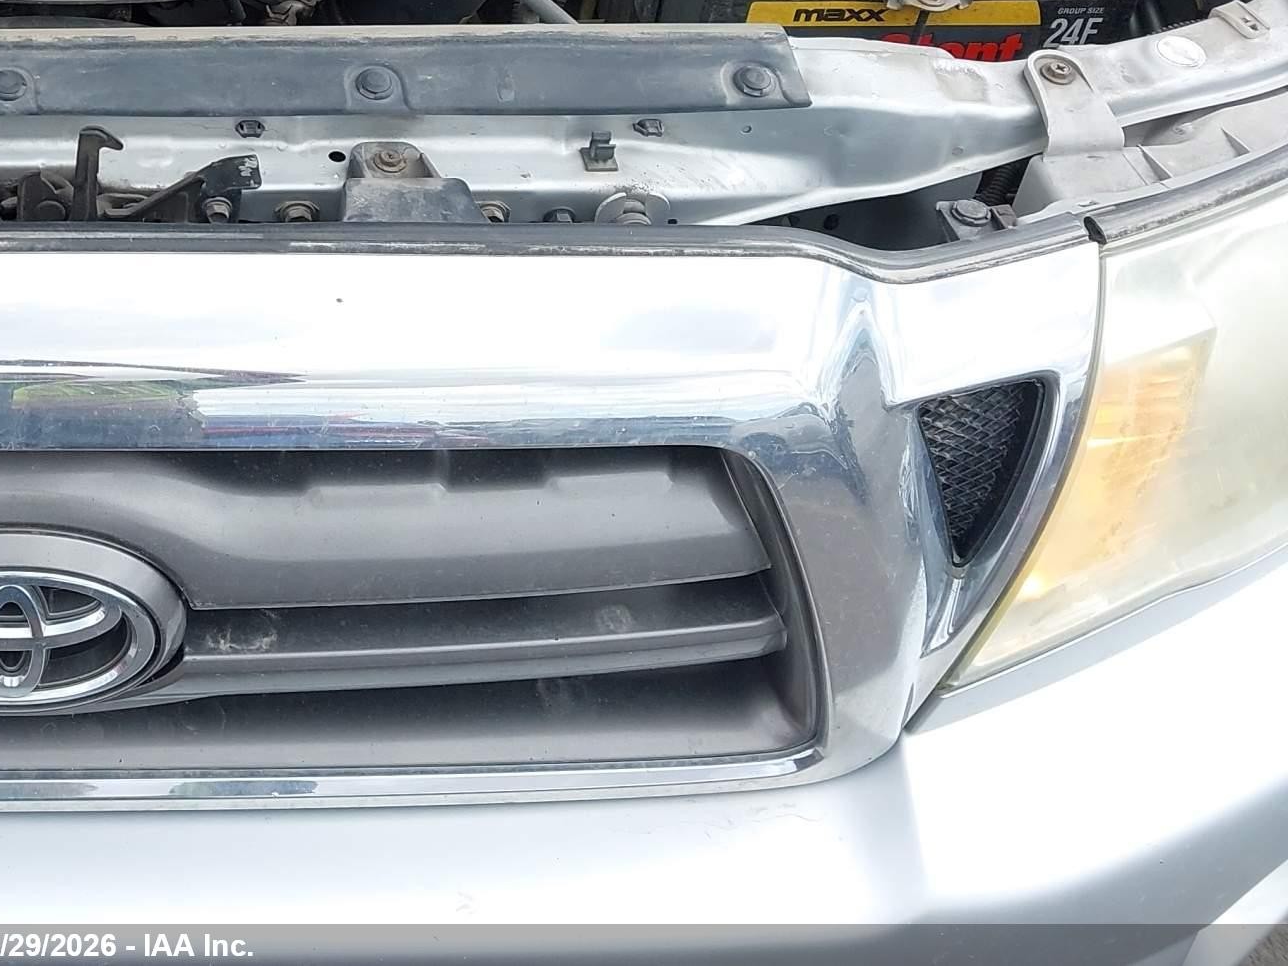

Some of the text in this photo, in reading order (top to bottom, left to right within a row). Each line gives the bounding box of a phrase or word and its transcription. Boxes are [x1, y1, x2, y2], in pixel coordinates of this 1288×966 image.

[793, 8, 887, 22] maxx
[1057, 7, 1087, 15] GROUP
[1043, 17, 1103, 48] 24F
